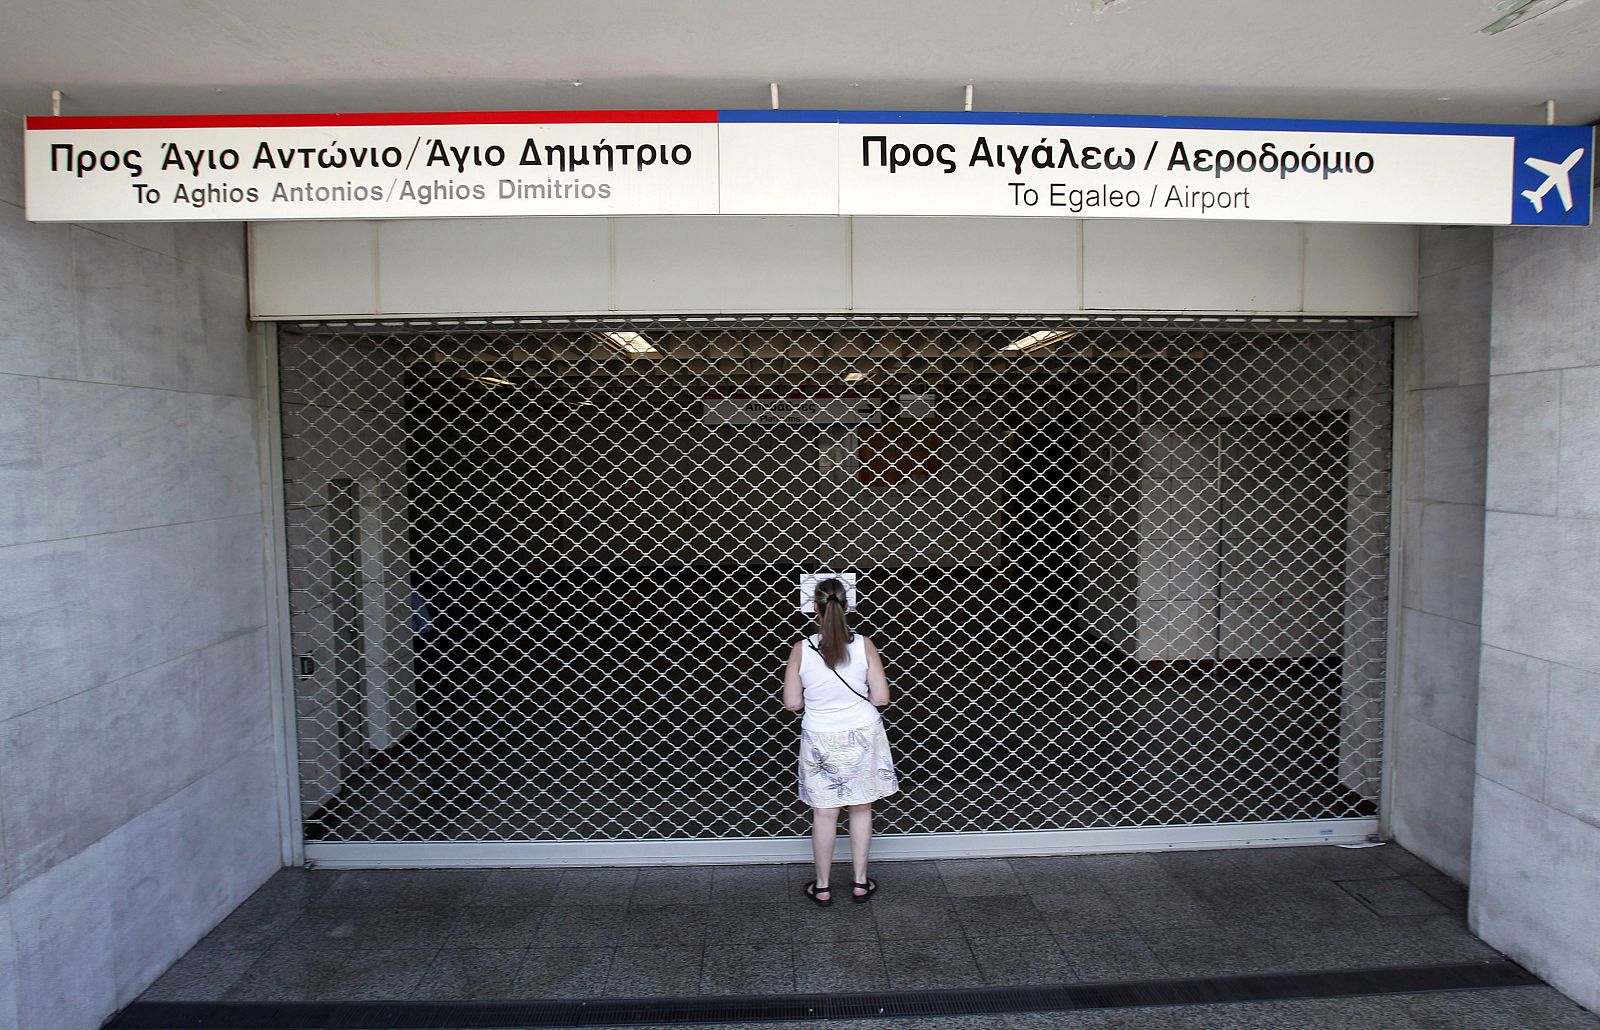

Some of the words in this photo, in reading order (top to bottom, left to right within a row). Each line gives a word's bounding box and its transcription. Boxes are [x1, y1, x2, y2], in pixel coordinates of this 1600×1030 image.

[50, 142, 143, 178] Προς
[160, 142, 239, 177] Άγιο
[519, 138, 691, 173] Δημήτριο
[863, 136, 956, 173] Προς
[969, 137, 1135, 175] Αιγάλεω
[1167, 141, 1374, 180] Αεροδρόμιο
[132, 183, 161, 205] To
[173, 182, 259, 208] Aghios
[499, 179, 610, 199] Dimitrios
[1008, 183, 1038, 207] To
[1050, 184, 1140, 213] Egaleo
[1164, 185, 1250, 214] Airport
